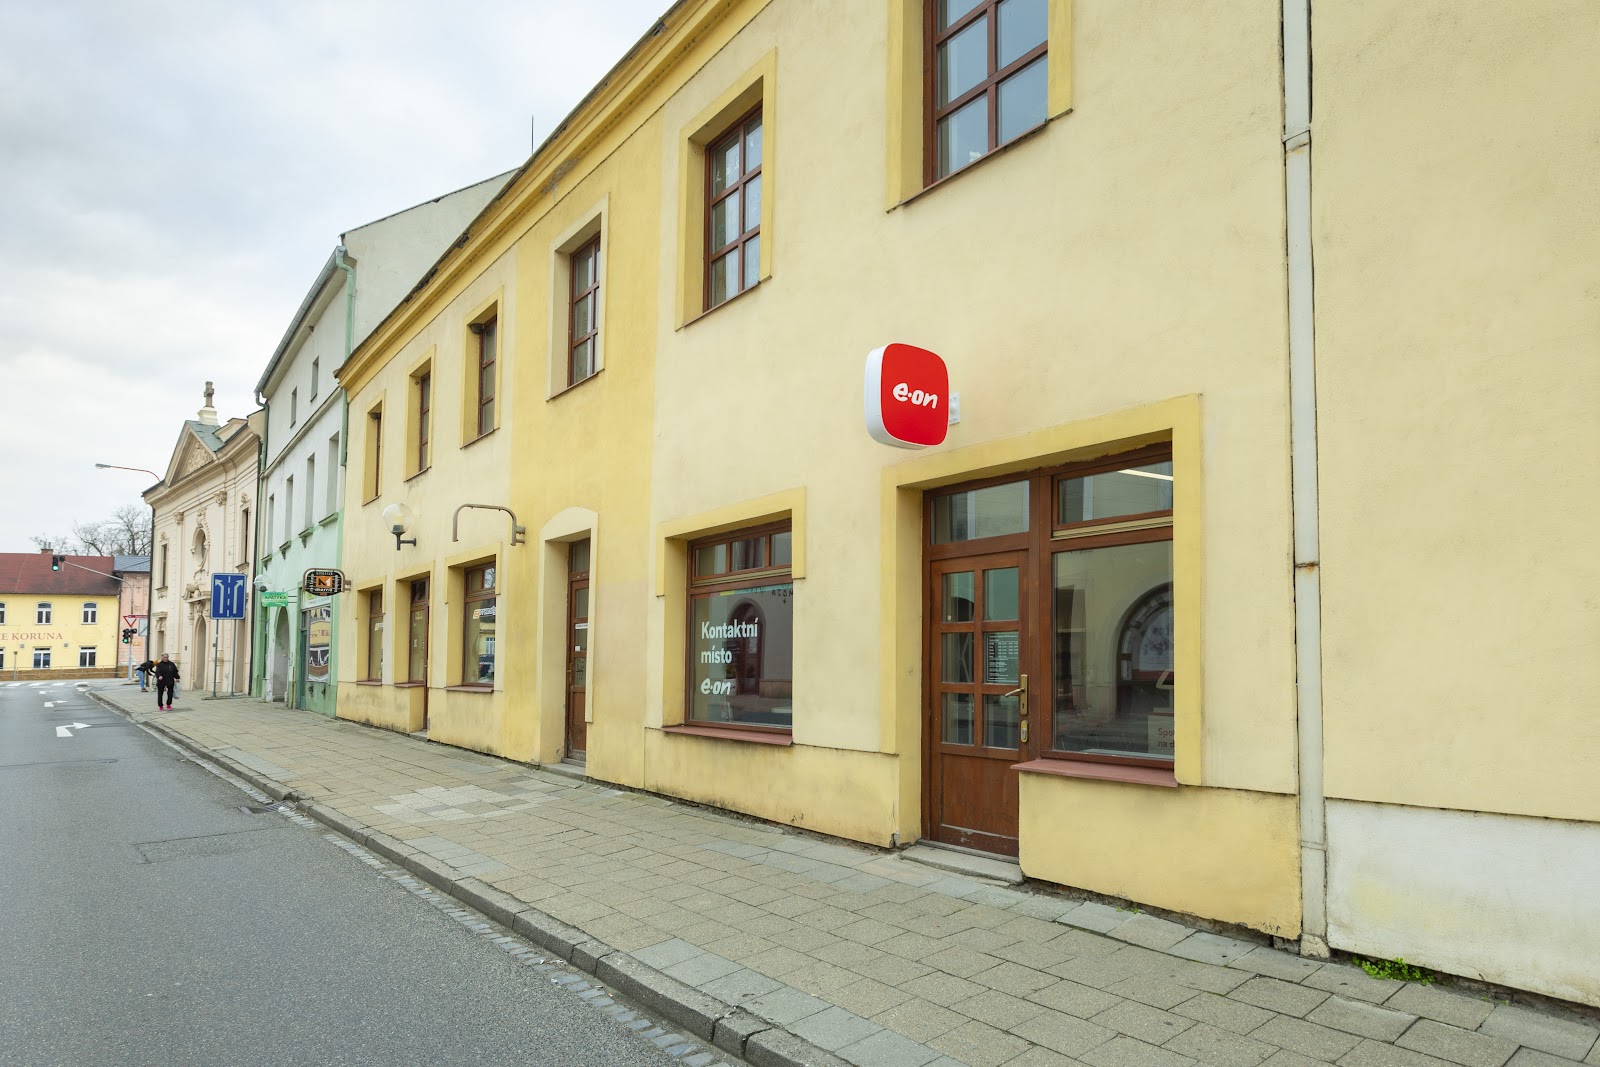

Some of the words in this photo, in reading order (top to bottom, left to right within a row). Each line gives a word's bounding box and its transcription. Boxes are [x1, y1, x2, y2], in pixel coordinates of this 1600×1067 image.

[0, 632, 8, 640] E
[12, 632, 63, 640] KORUNA
[701, 617, 758, 639] Kontaktní
[701, 645, 732, 664] místo
